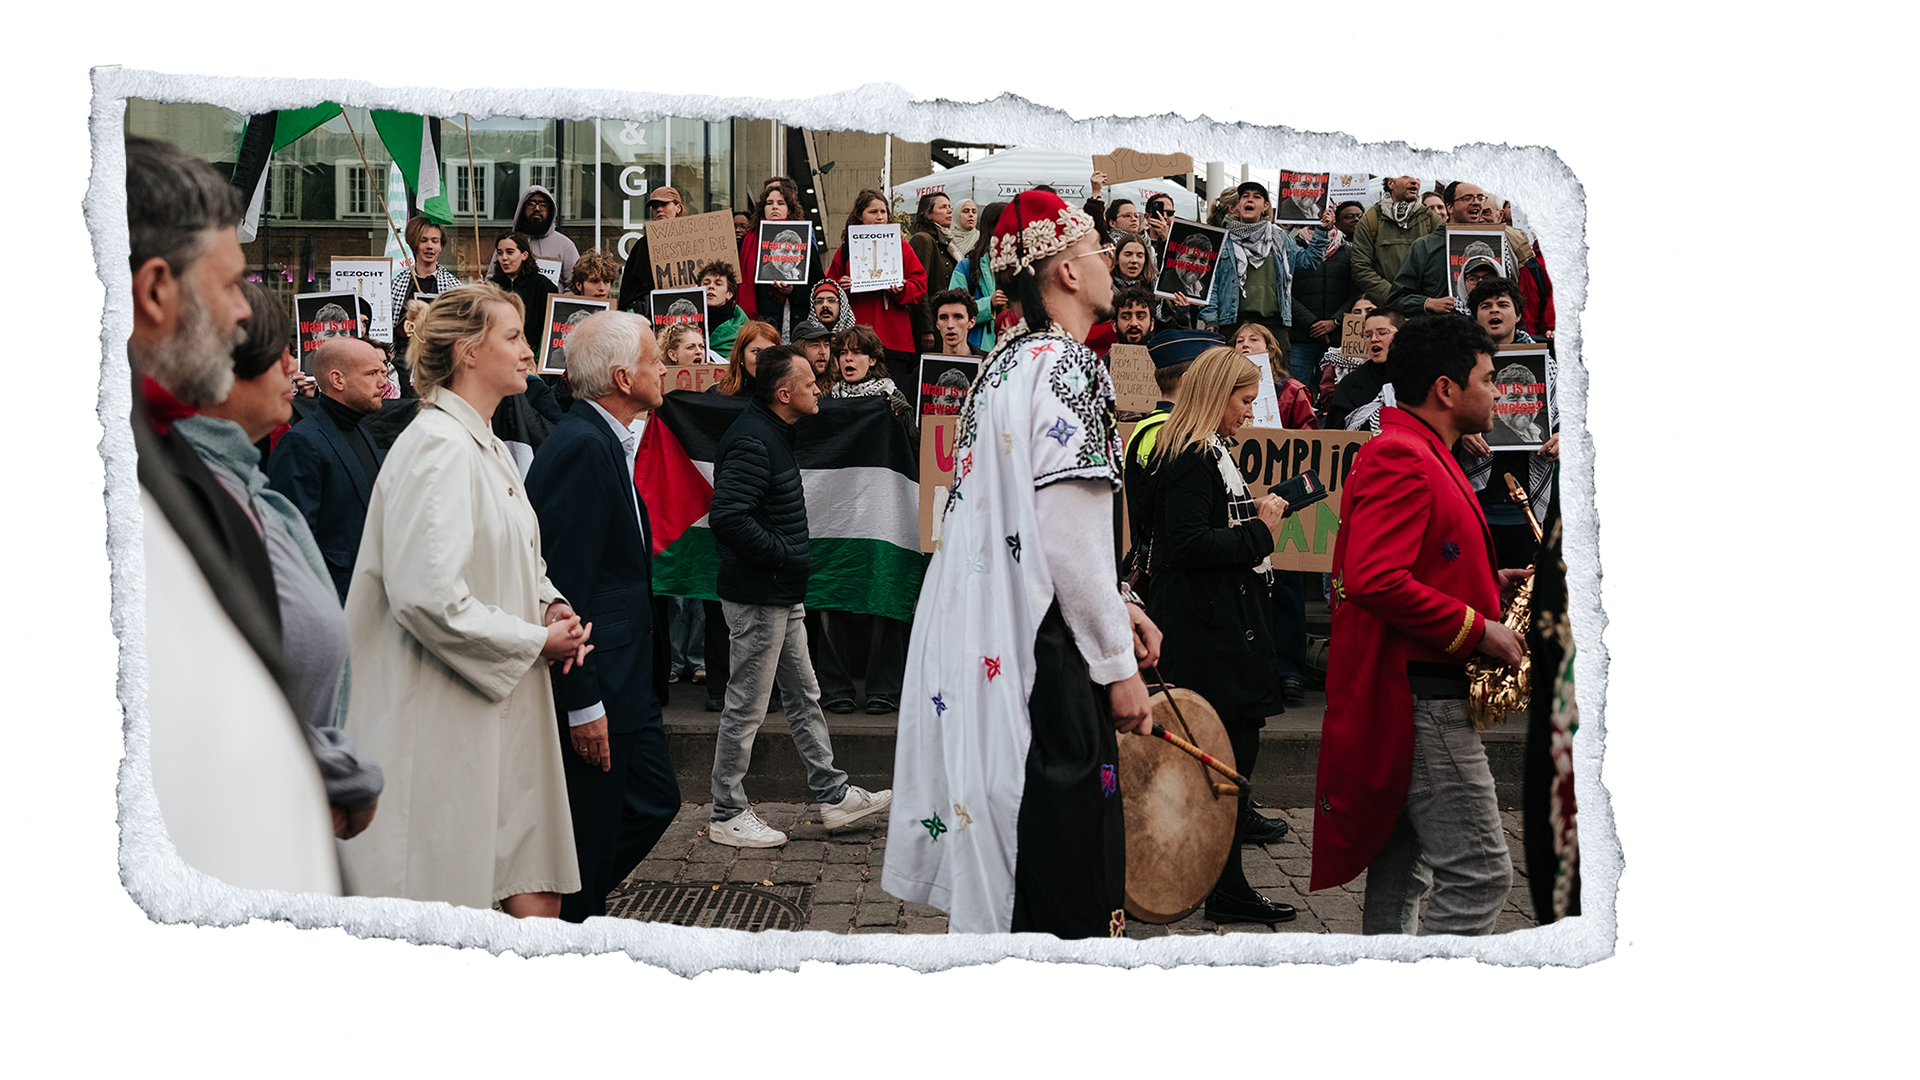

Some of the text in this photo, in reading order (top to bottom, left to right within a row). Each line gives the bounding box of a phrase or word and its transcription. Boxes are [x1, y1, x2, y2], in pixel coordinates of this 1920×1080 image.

[1281, 172, 1329, 183] Waar is uw
[1282, 187, 1325, 198] geweten?
[617, 165, 648, 270] GLO
[852, 232, 895, 240] GEZOCHT
[652, 236, 728, 262] BESTAAT DE
[761, 240, 807, 251] Waar is uw
[1168, 240, 1218, 261] Waar is uw
[762, 254, 805, 263] geweten?
[1166, 257, 1212, 275] geweten?
[654, 312, 704, 326] Waar is uw
[300, 319, 357, 334] Waar is uw
[552, 321, 574, 334] Waa
[922, 382, 948, 397] Waar
[950, 384, 960, 398] is
[1496, 381, 1545, 395] ar is uw
[1494, 400, 1544, 415] eweten?
